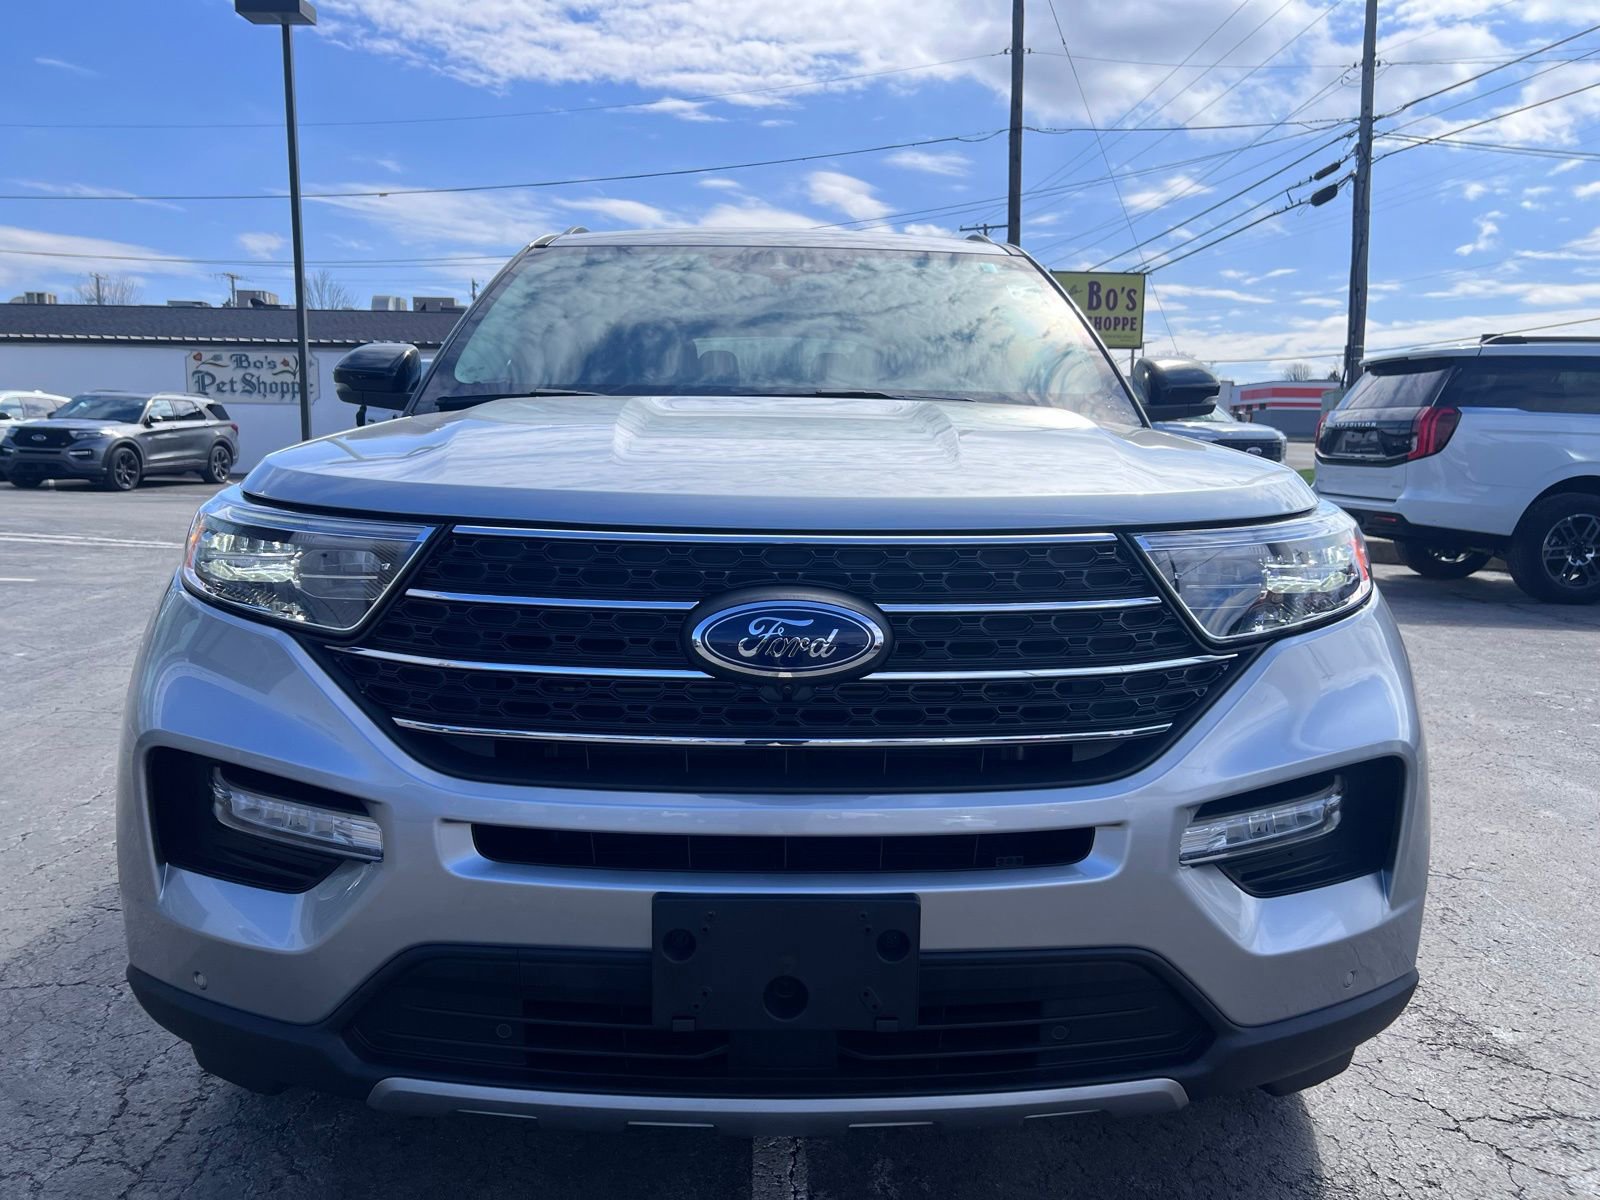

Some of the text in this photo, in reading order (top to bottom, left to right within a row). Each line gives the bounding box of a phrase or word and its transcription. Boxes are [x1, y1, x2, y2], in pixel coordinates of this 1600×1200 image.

[230, 353, 277, 370] Bo's
[192, 370, 313, 399] Pet Shopp
[738, 616, 839, 658] Ford
